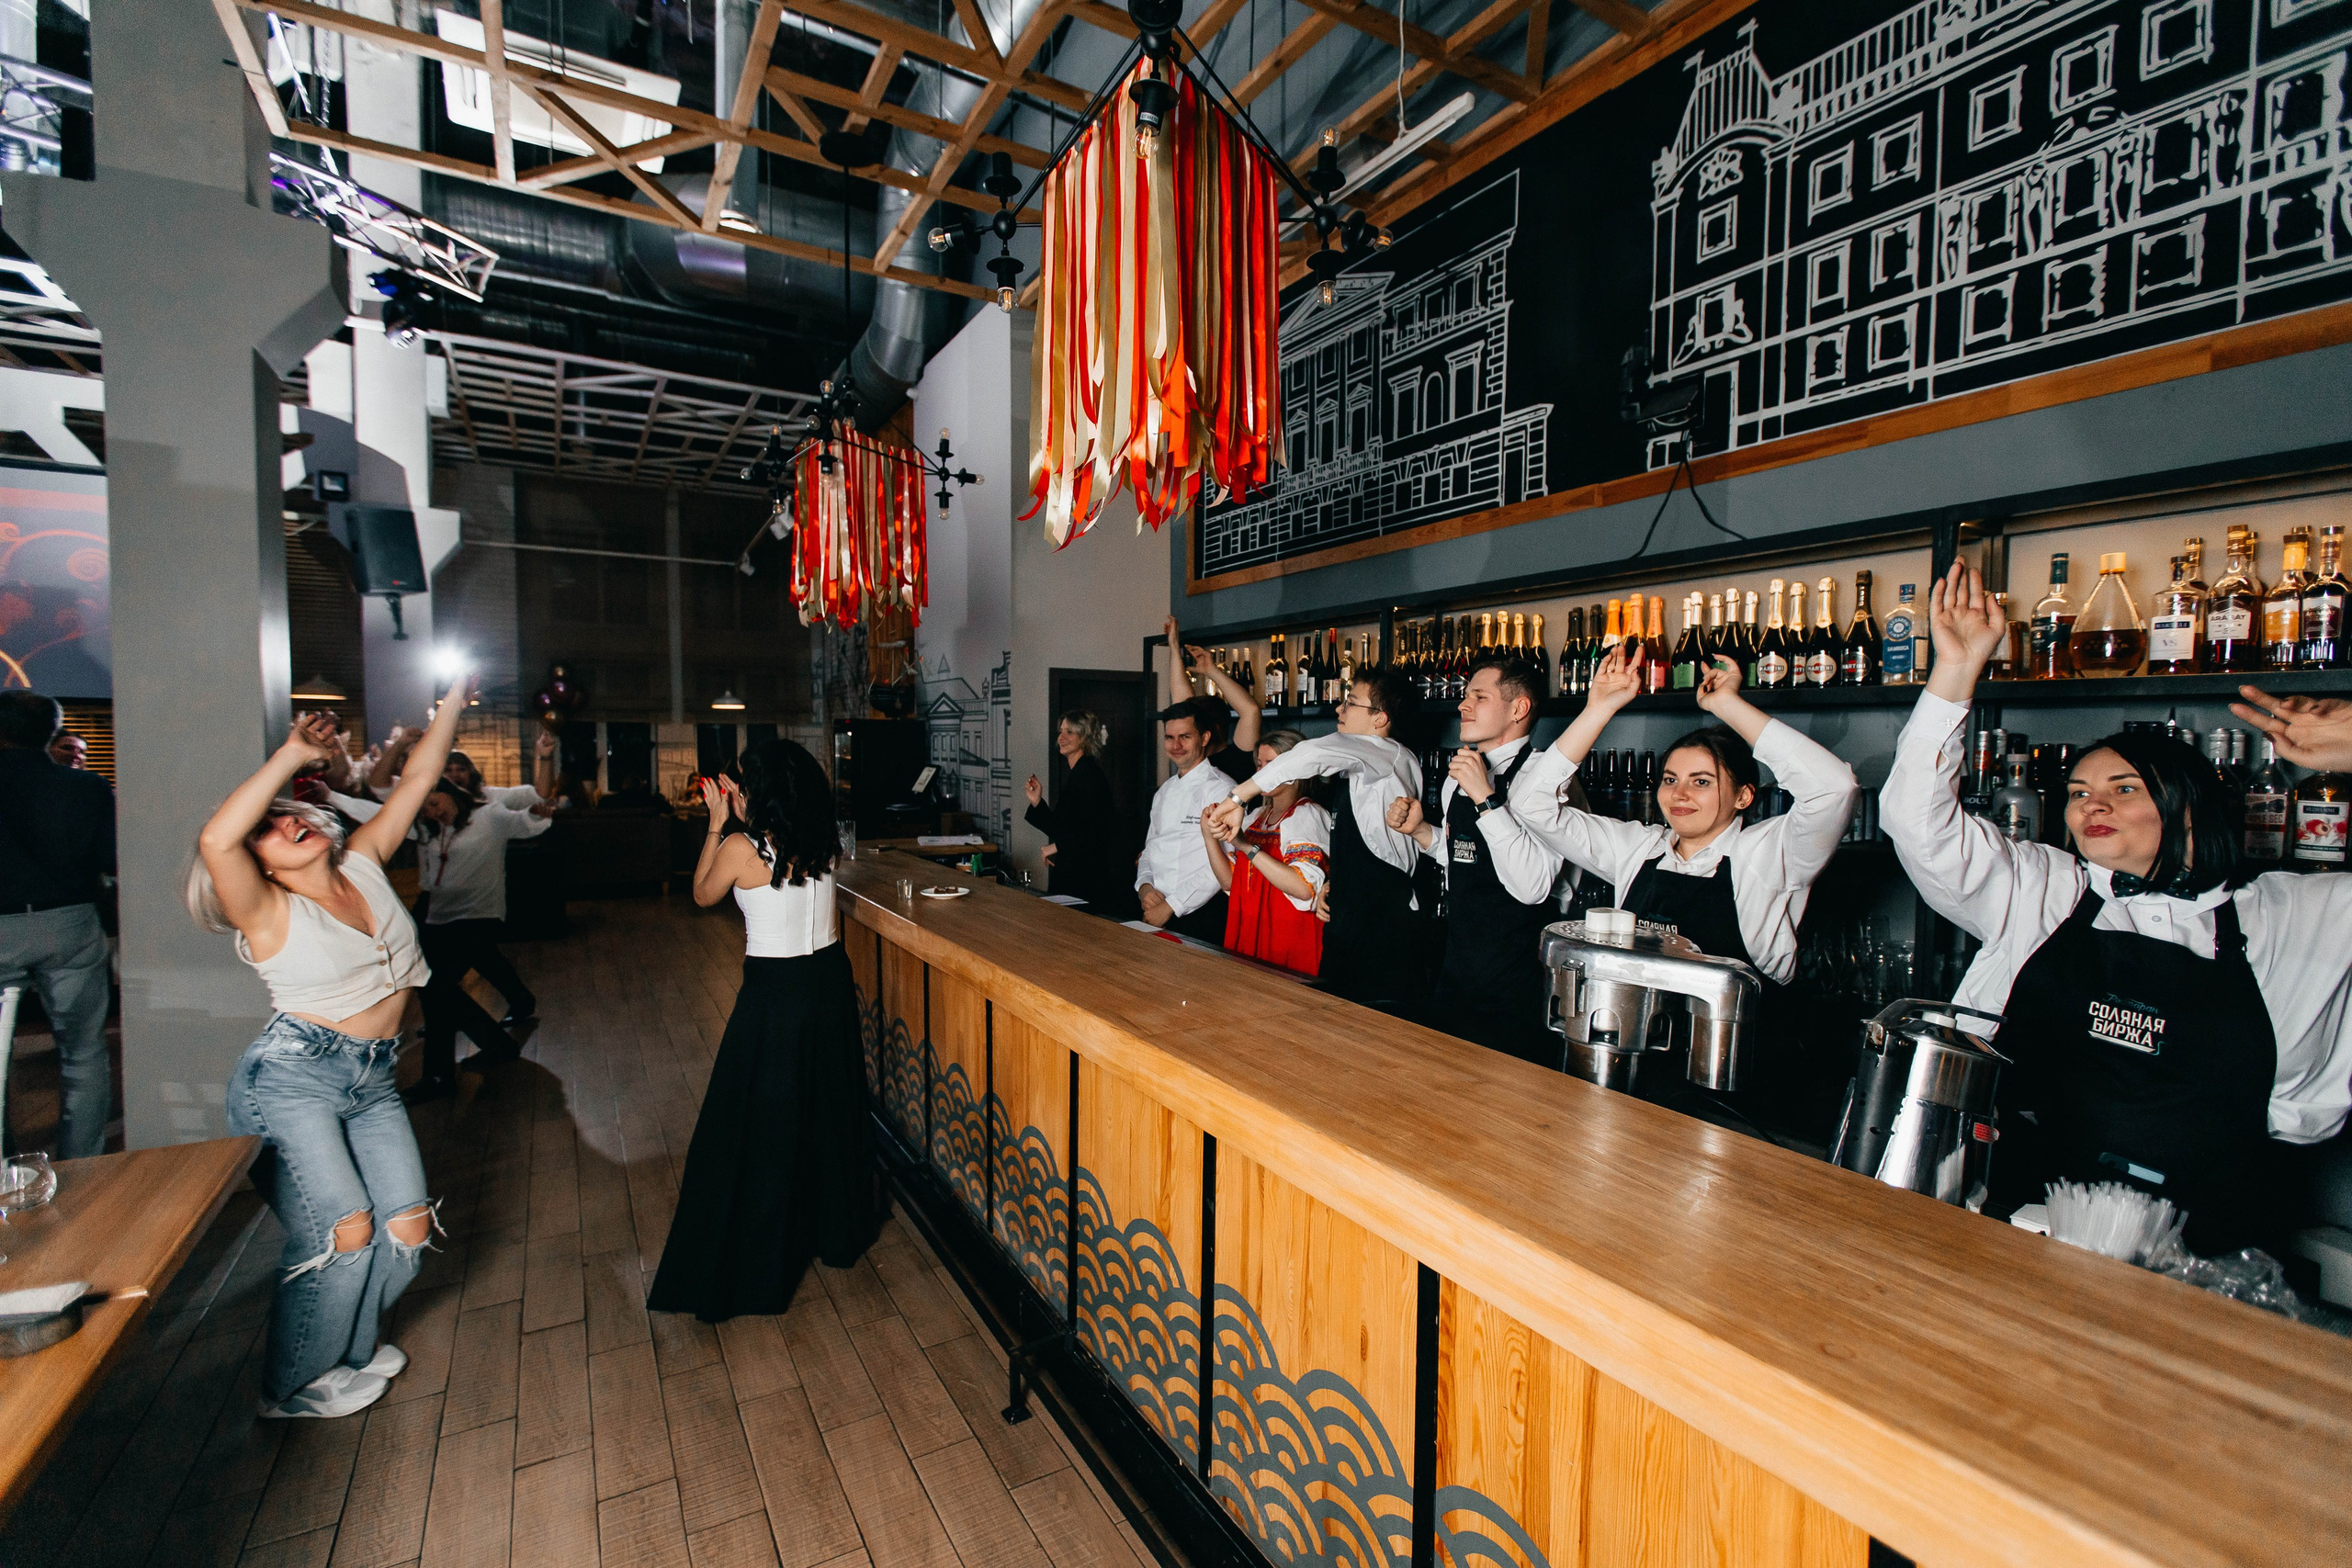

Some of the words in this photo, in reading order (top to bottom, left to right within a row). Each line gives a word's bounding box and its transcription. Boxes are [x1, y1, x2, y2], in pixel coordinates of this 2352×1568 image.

[1964, 796, 1988, 805] BOLS
[2268, 814, 2283, 823] SEC
[2088, 1001, 2166, 1034] СОЛЯНАЯ
[2092, 1017, 2154, 1047] БИРЖА
